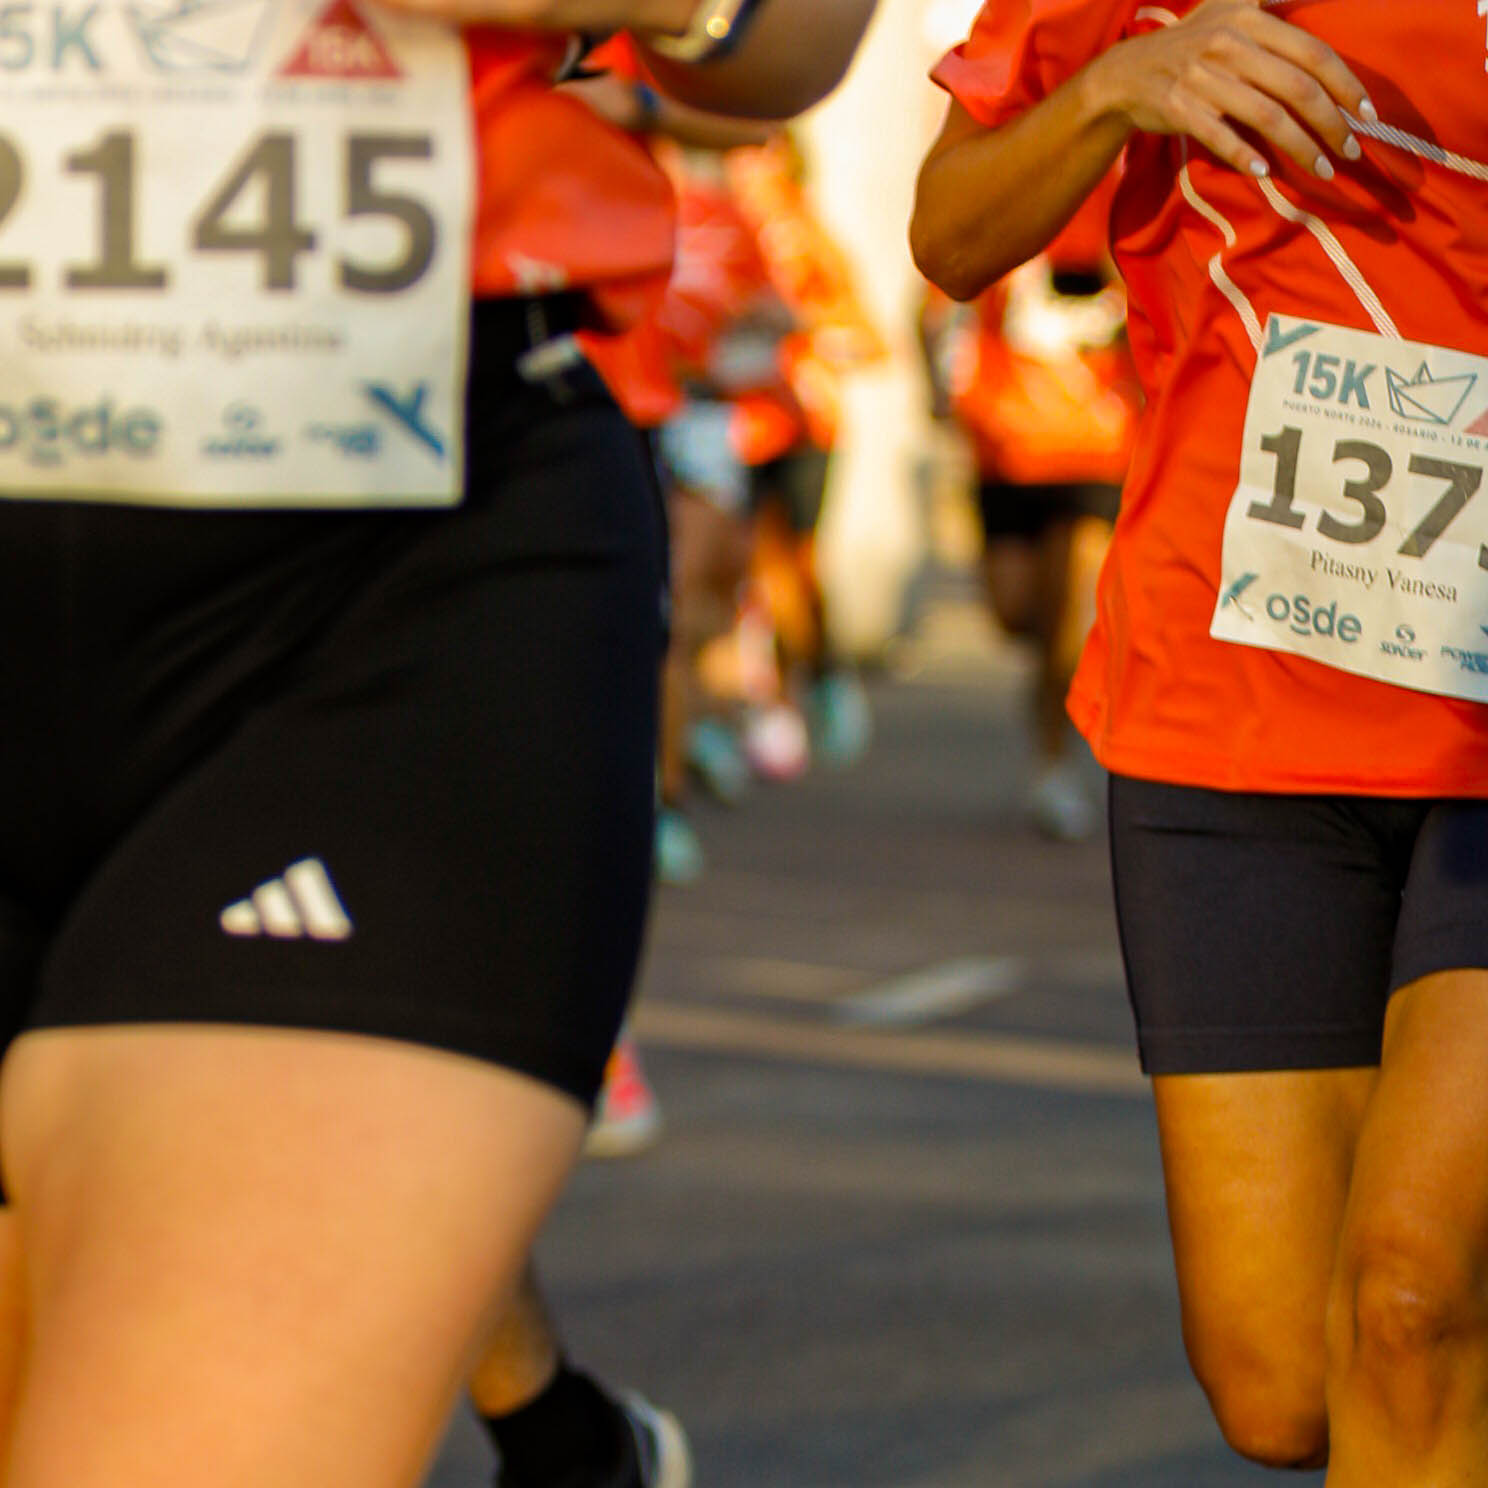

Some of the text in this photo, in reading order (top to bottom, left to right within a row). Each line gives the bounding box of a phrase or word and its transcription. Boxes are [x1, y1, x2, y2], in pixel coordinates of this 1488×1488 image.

[1292, 350, 1376, 409] 15K
[1282, 400, 1321, 416] PUERTO
[1324, 409, 1355, 424] NORTE
[1247, 424, 1488, 571] 137
[1310, 549, 1458, 603] Pitasny Vanesa
[1266, 594, 1362, 643] osde
